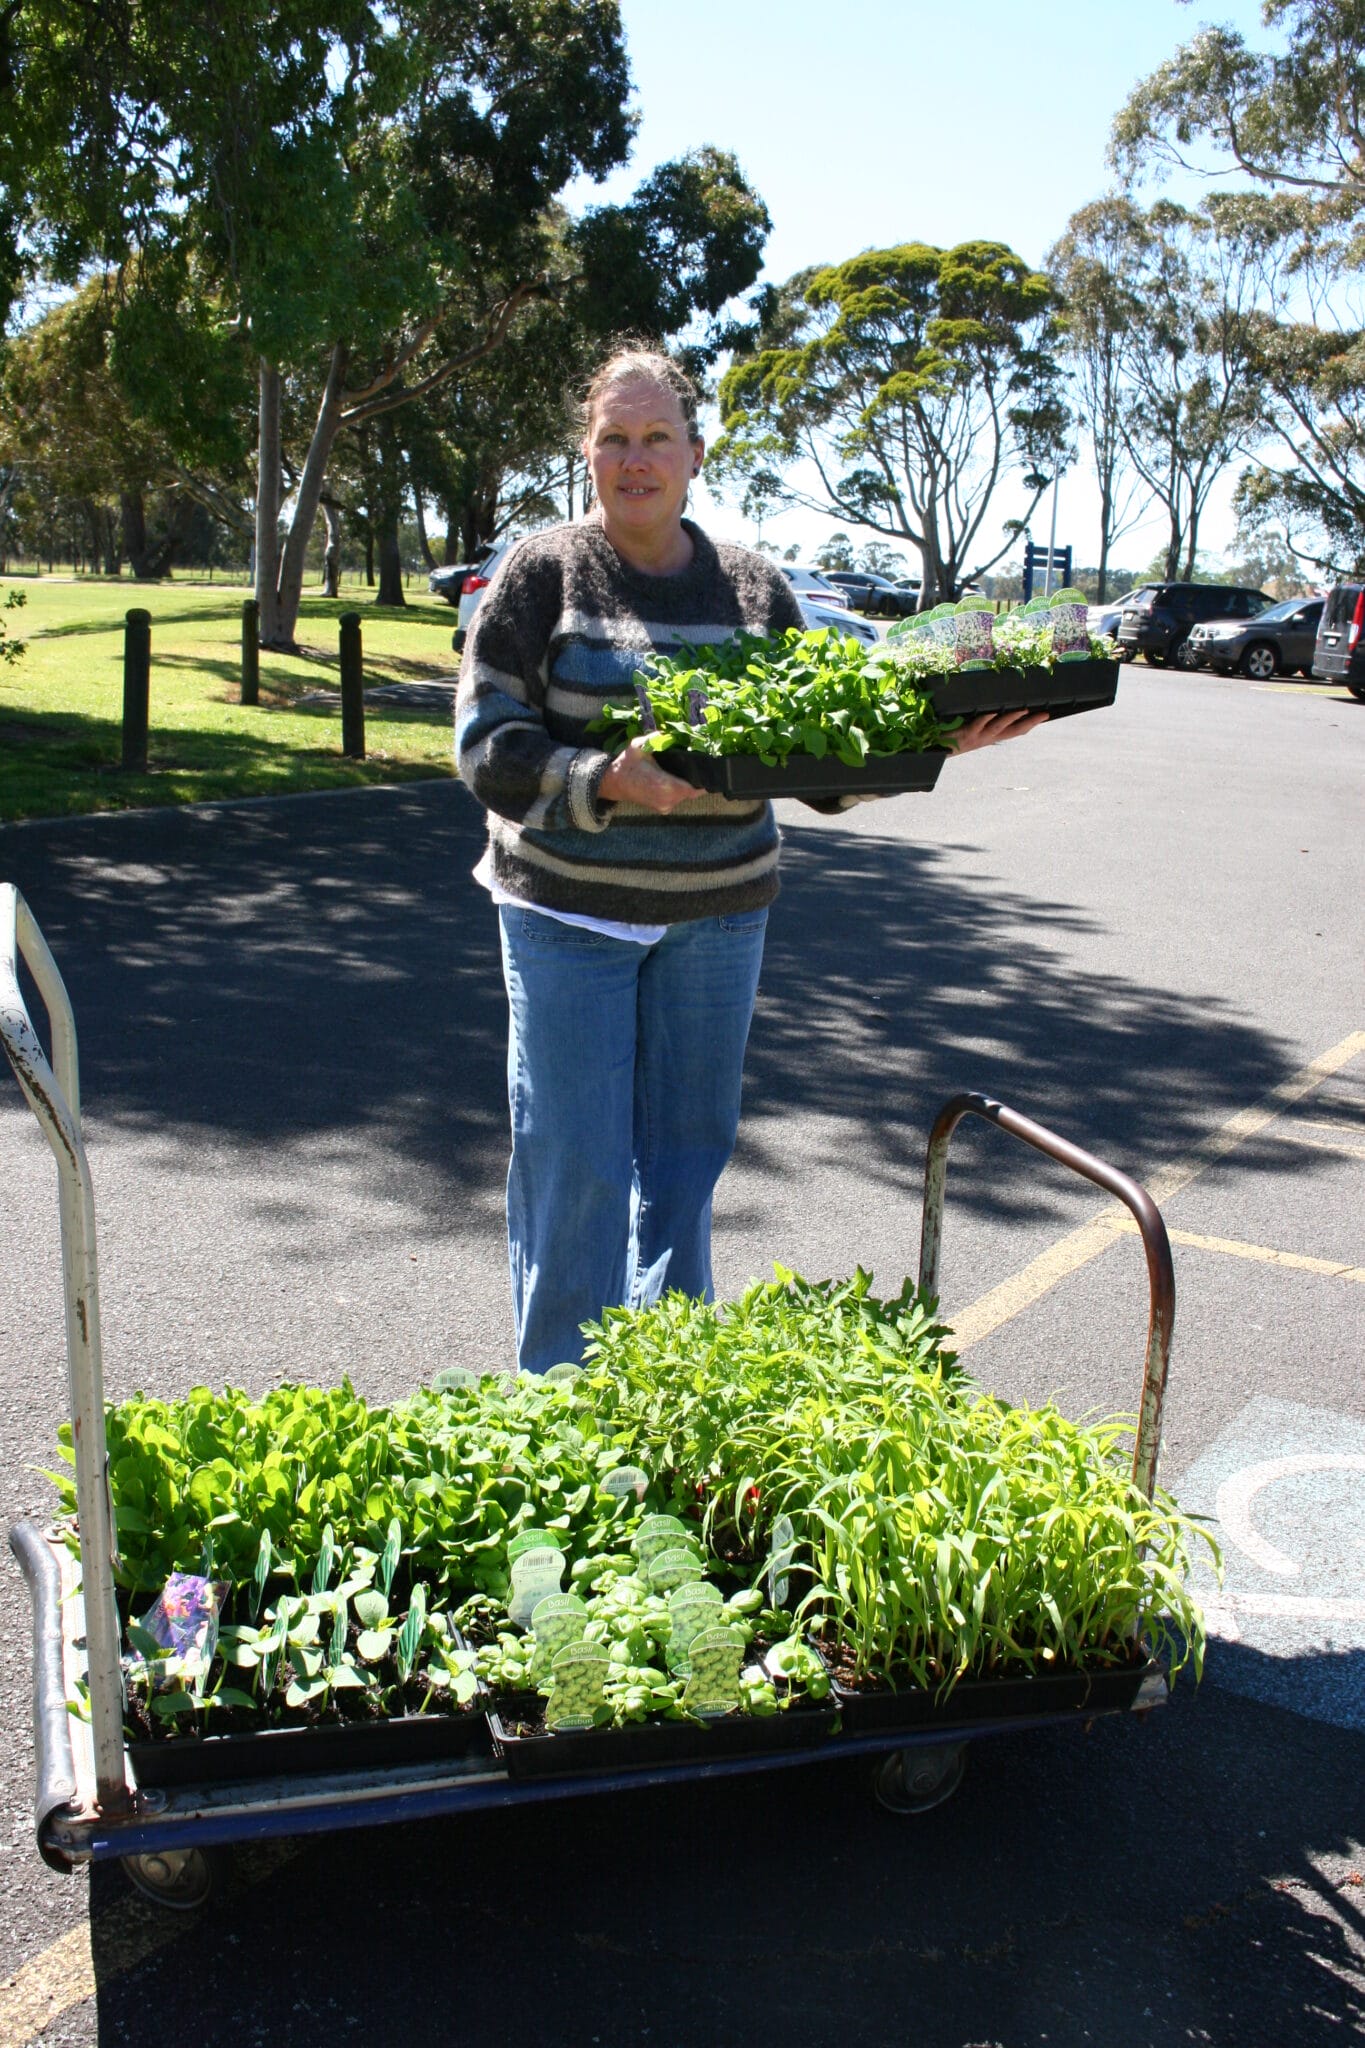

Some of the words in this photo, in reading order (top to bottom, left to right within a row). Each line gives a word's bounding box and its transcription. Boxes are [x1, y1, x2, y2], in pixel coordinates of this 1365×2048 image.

[522, 1532, 544, 1543] Basil
[685, 1585, 707, 1596] Basil
[547, 1598, 570, 1608] Basil
[706, 1631, 729, 1641] Basil
[570, 1645, 594, 1656] Basil
